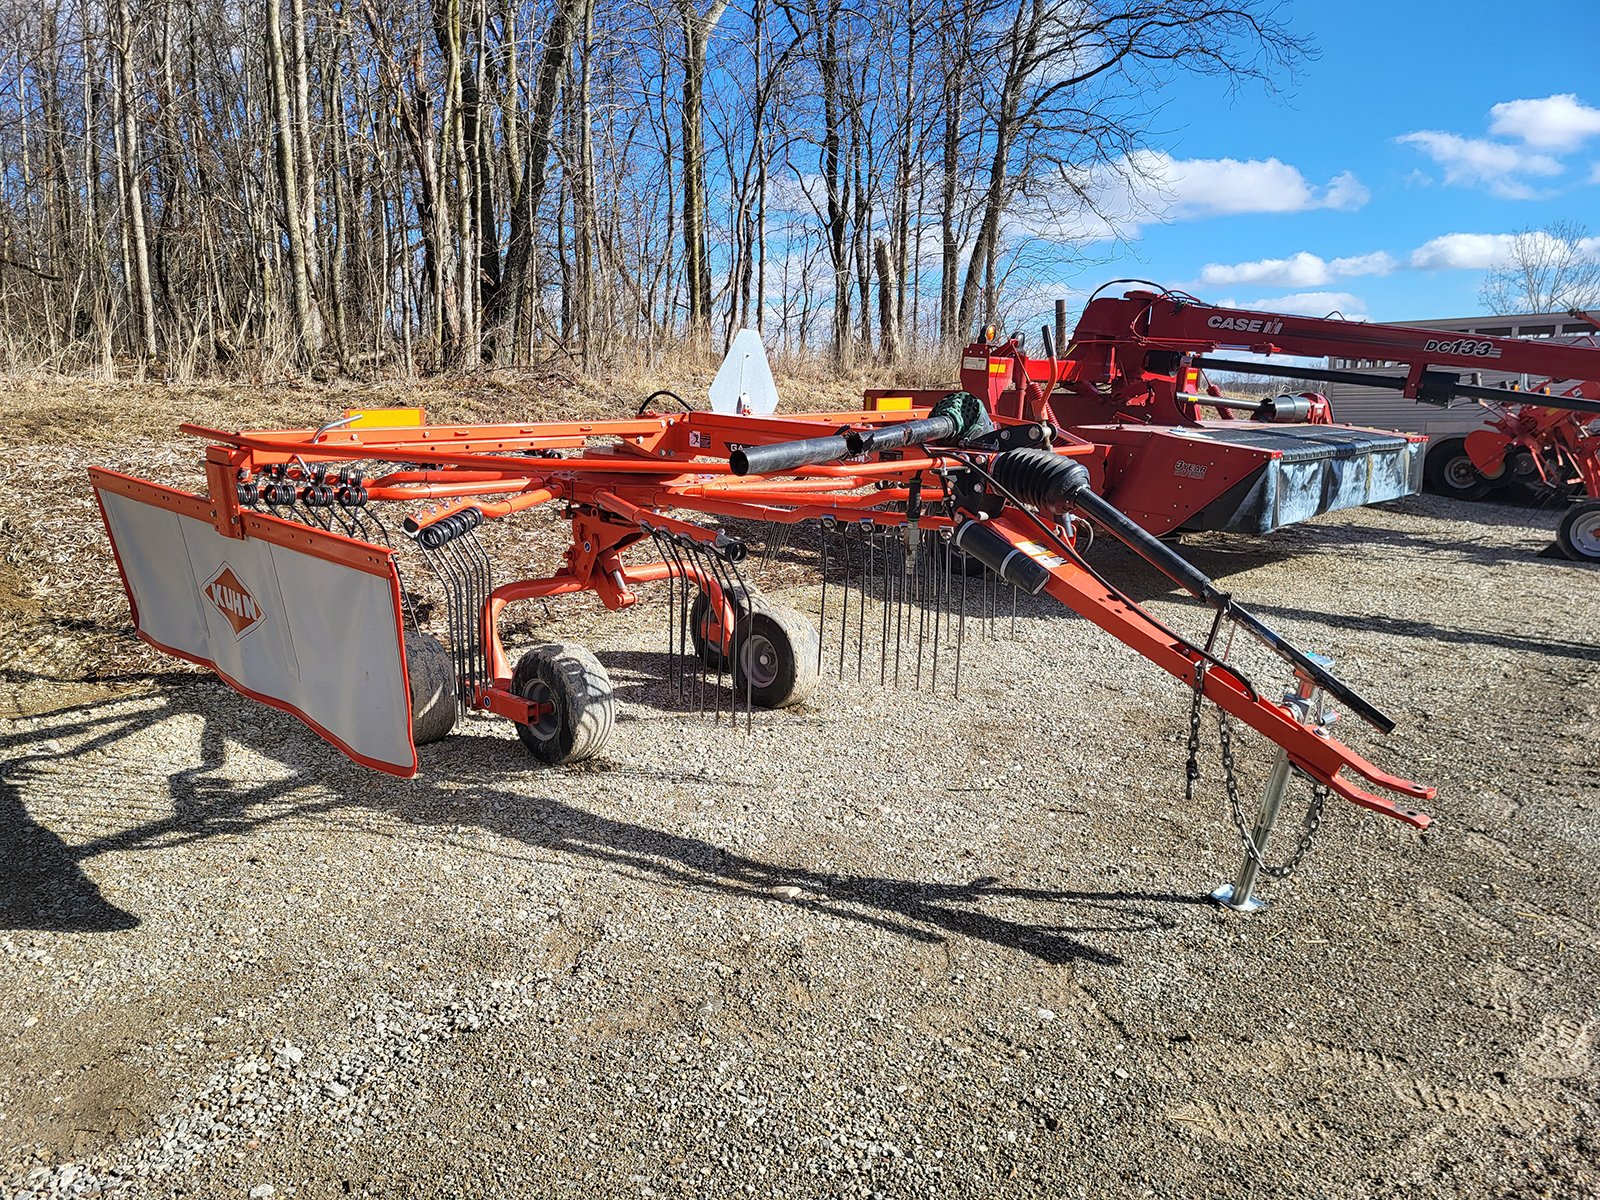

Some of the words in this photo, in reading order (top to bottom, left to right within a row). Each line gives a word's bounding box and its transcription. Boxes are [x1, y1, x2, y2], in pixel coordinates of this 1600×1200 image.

[1207, 315, 1263, 333] CASE
[1183, 463, 1208, 474] YEAR
[210, 582, 258, 621] KUHN
